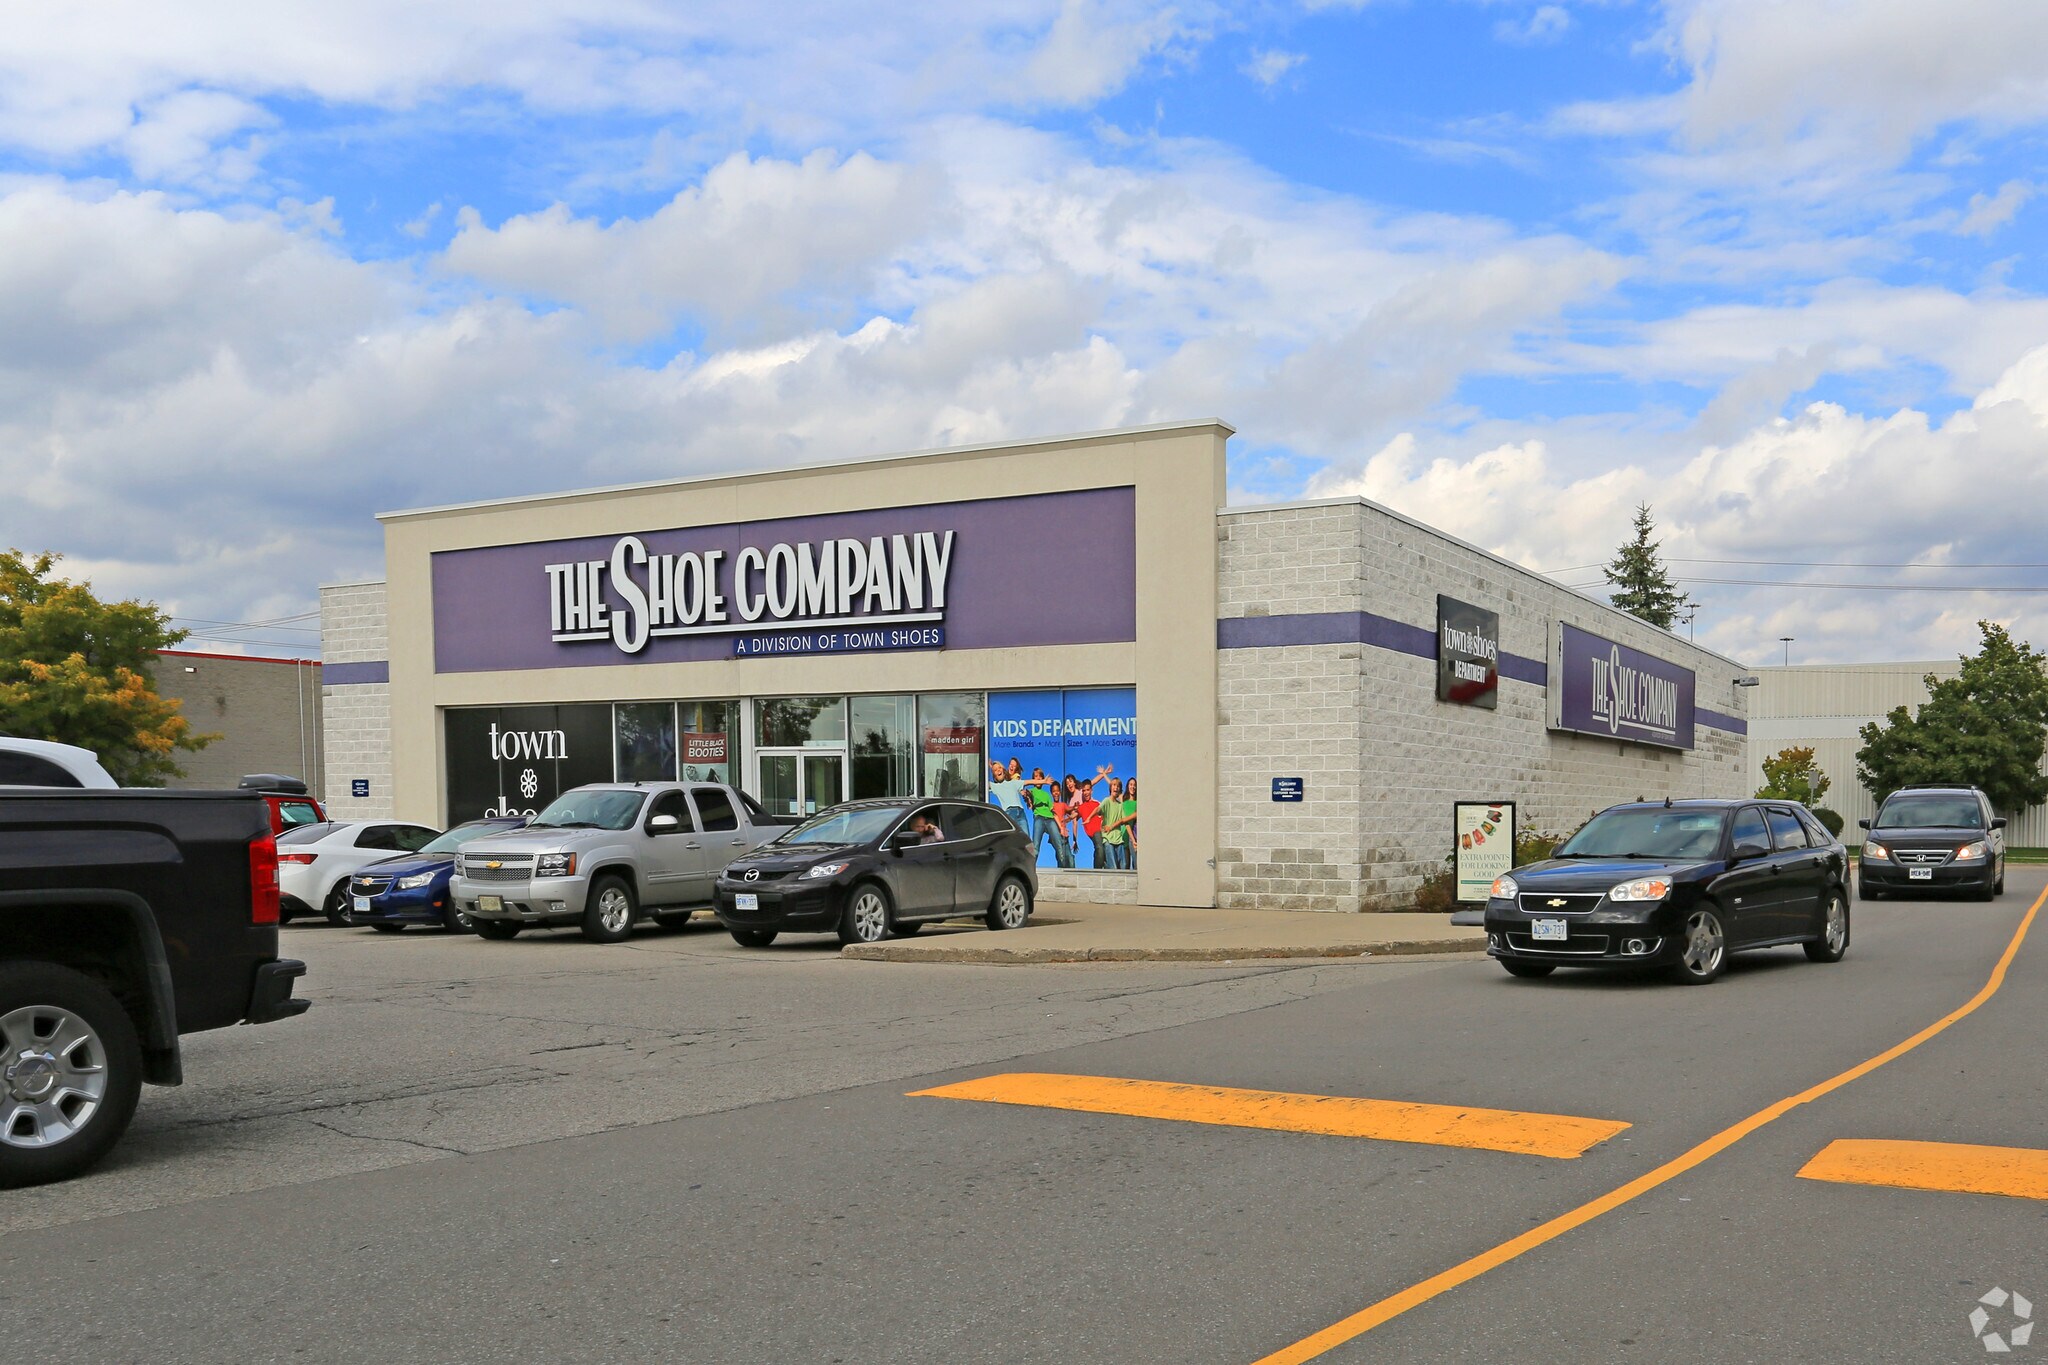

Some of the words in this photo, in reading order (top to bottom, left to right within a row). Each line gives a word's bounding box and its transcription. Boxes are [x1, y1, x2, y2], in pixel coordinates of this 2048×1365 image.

[545, 560, 611, 631] THE
[609, 535, 729, 654] SHOE
[734, 529, 957, 622] COMPANY
[737, 640, 746, 653] A
[752, 636, 812, 653] DIVISION
[818, 634, 838, 650] OF
[844, 632, 884, 648] TOWN
[891, 628, 940, 646] SHOES
[1444, 620, 1467, 653] town
[1473, 625, 1497, 661] shoes
[1454, 659, 1487, 684] DEPARTMENT
[1591, 656, 1609, 715] THE
[1609, 644, 1637, 734] SHOE
[1638, 671, 1678, 729] COMPANY
[993, 720, 1028, 738] KIDS
[1031, 717, 1137, 737] DEPARTMENT
[488, 722, 568, 760] town
[688, 739, 710, 747] LITTLE
[709, 738, 725, 747] BLACK
[930, 736, 960, 744] madden
[961, 736, 975, 745] girl
[994, 740, 1011, 748] More
[1012, 740, 1034, 748] Brands
[1067, 739, 1083, 747] Sizes
[1092, 739, 1110, 747] More
[688, 747, 724, 758] BOOTIES
[1460, 853, 1483, 861] EXTRA
[1483, 853, 1510, 861] POINTS
[1473, 870, 1495, 878] GOOD
